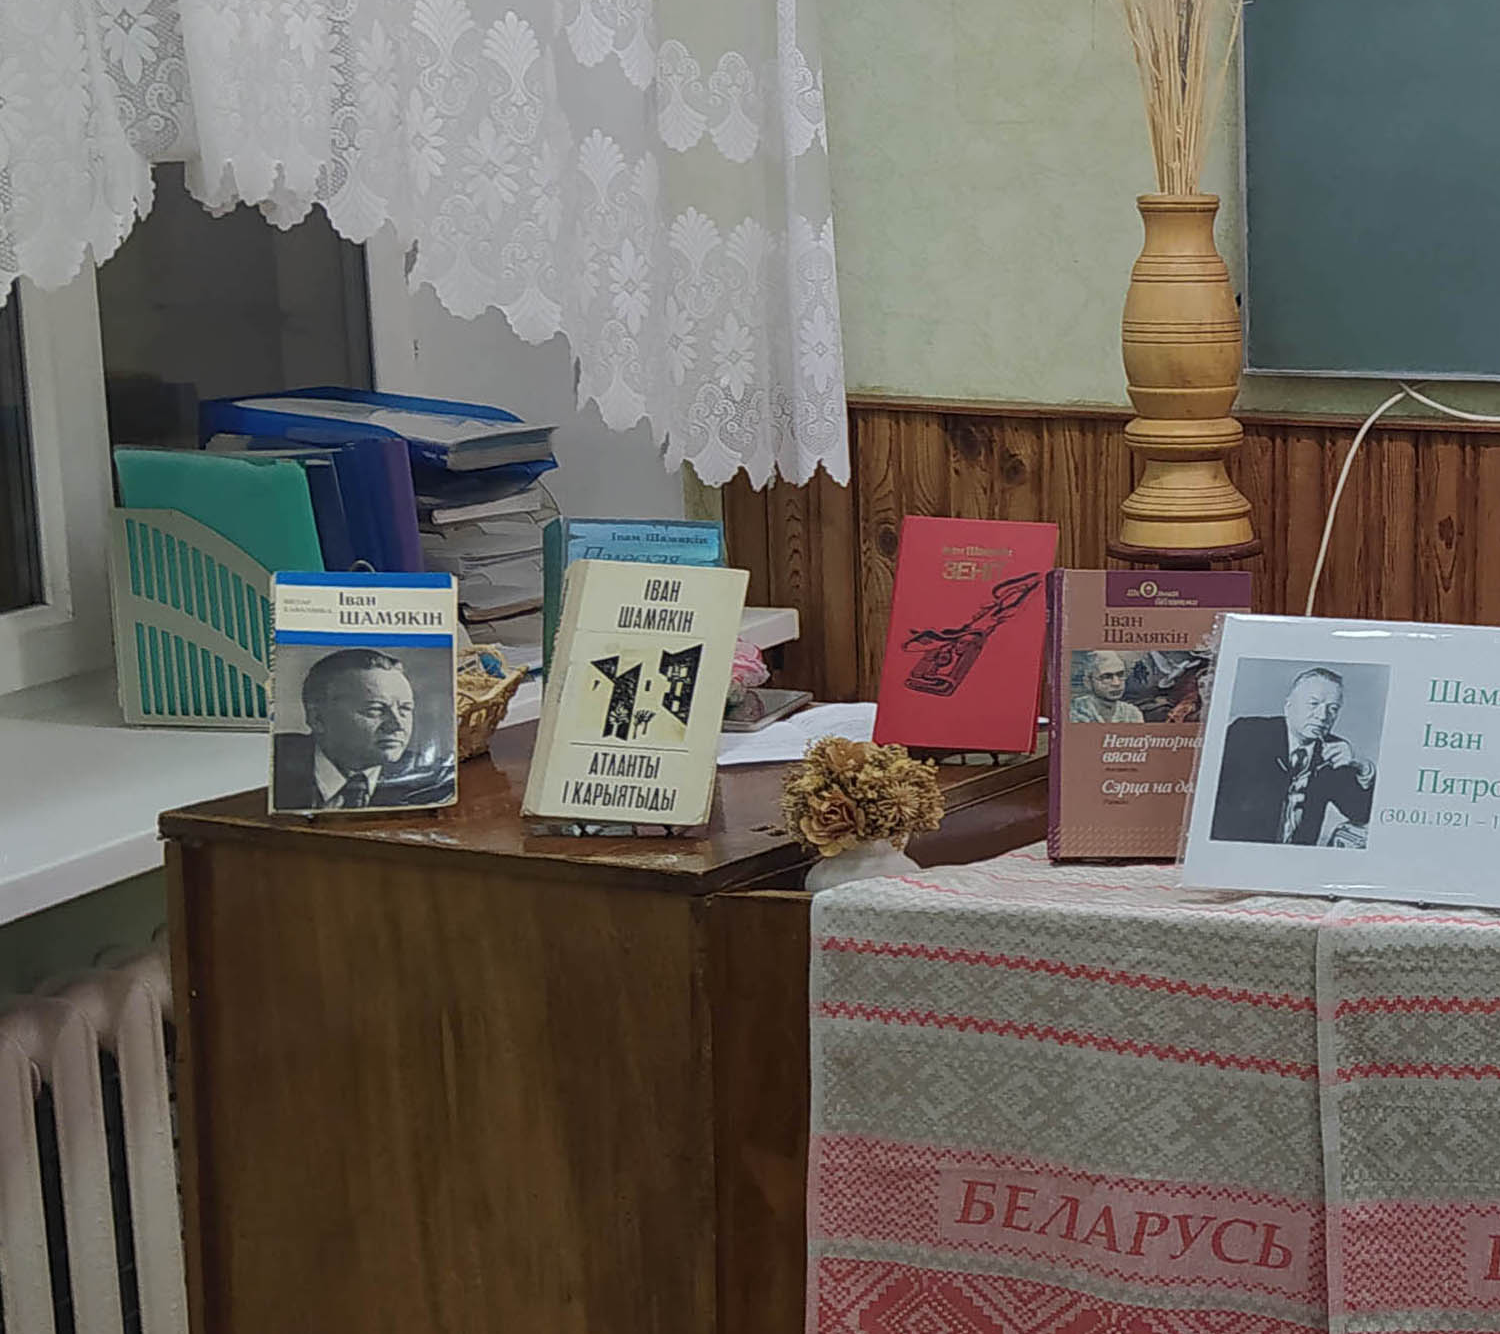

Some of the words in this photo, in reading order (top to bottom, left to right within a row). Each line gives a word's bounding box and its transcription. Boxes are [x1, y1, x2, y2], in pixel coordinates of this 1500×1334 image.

[611, 532, 641, 543] Іван
[339, 591, 376, 607] Іван
[643, 578, 682, 603] ІВАН
[339, 610, 443, 626] ШАМЯКІН
[617, 605, 695, 634] ШАМЯКІН
[1104, 612, 1143, 628] Іван
[1103, 628, 1189, 644] Шамякін
[1423, 723, 1483, 751] Іван
[588, 752, 661, 780] АТЛАНТЫ
[1102, 751, 1148, 763] вясна
[562, 781, 570, 804] І
[571, 781, 677, 811] КАРЫЯТЫДЫ
[1101, 779, 1149, 798] Сэрца
[1152, 782, 1173, 794] на
[1380, 808, 1470, 827] (30.01.1921
[954, 1179, 1293, 1270] БЕЛАРУСЬ
